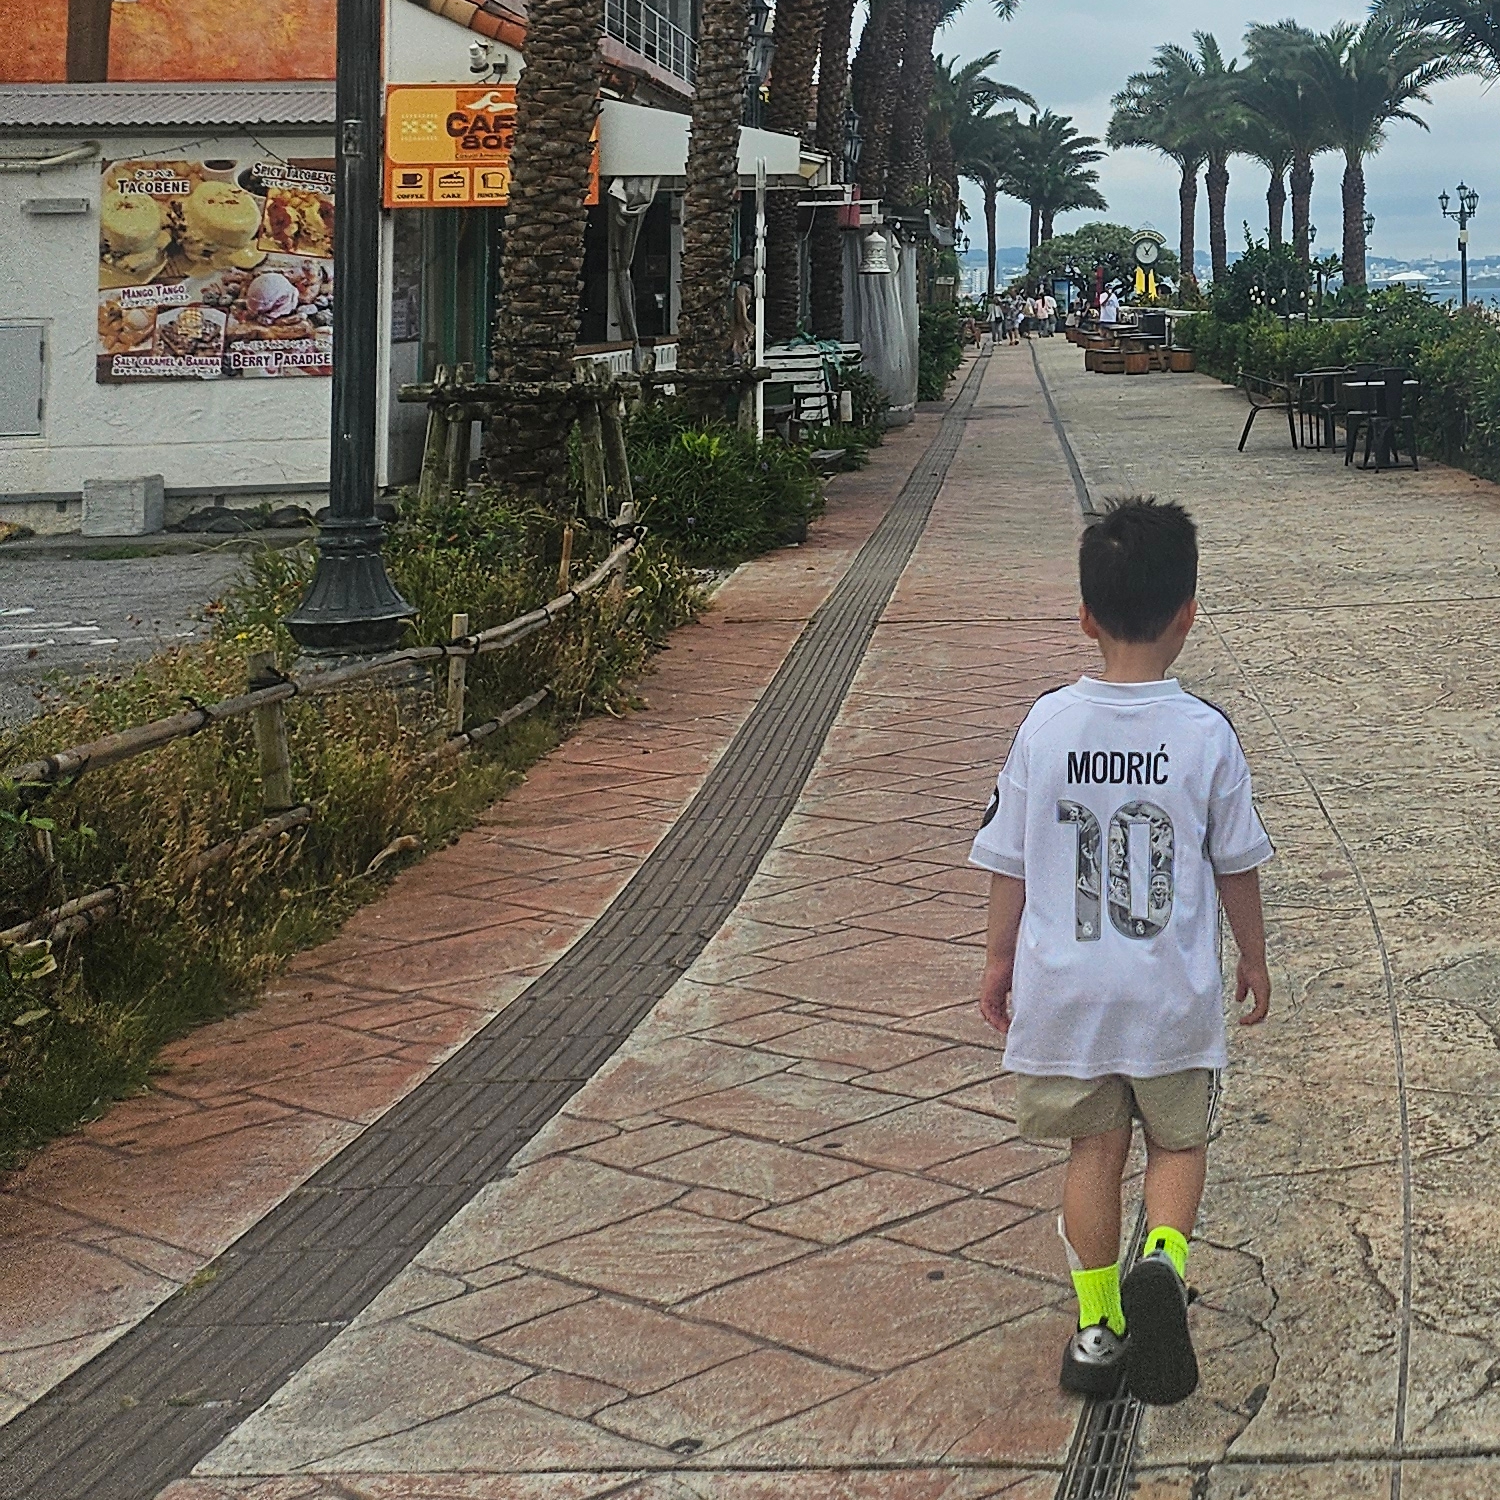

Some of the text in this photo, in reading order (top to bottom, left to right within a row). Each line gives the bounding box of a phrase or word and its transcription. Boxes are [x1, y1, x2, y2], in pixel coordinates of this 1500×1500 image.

[253, 162, 283, 177] SPICY
[118, 180, 189, 193] TACOBENE
[122, 286, 185, 299] MANGO TANGO
[113, 355, 138, 366] SALT
[185, 356, 220, 366] BANANA
[232, 352, 331, 367] BERRY PARADISE
[1067, 743, 1169, 785] MODRIĆ
[1056, 799, 1175, 942] 10
